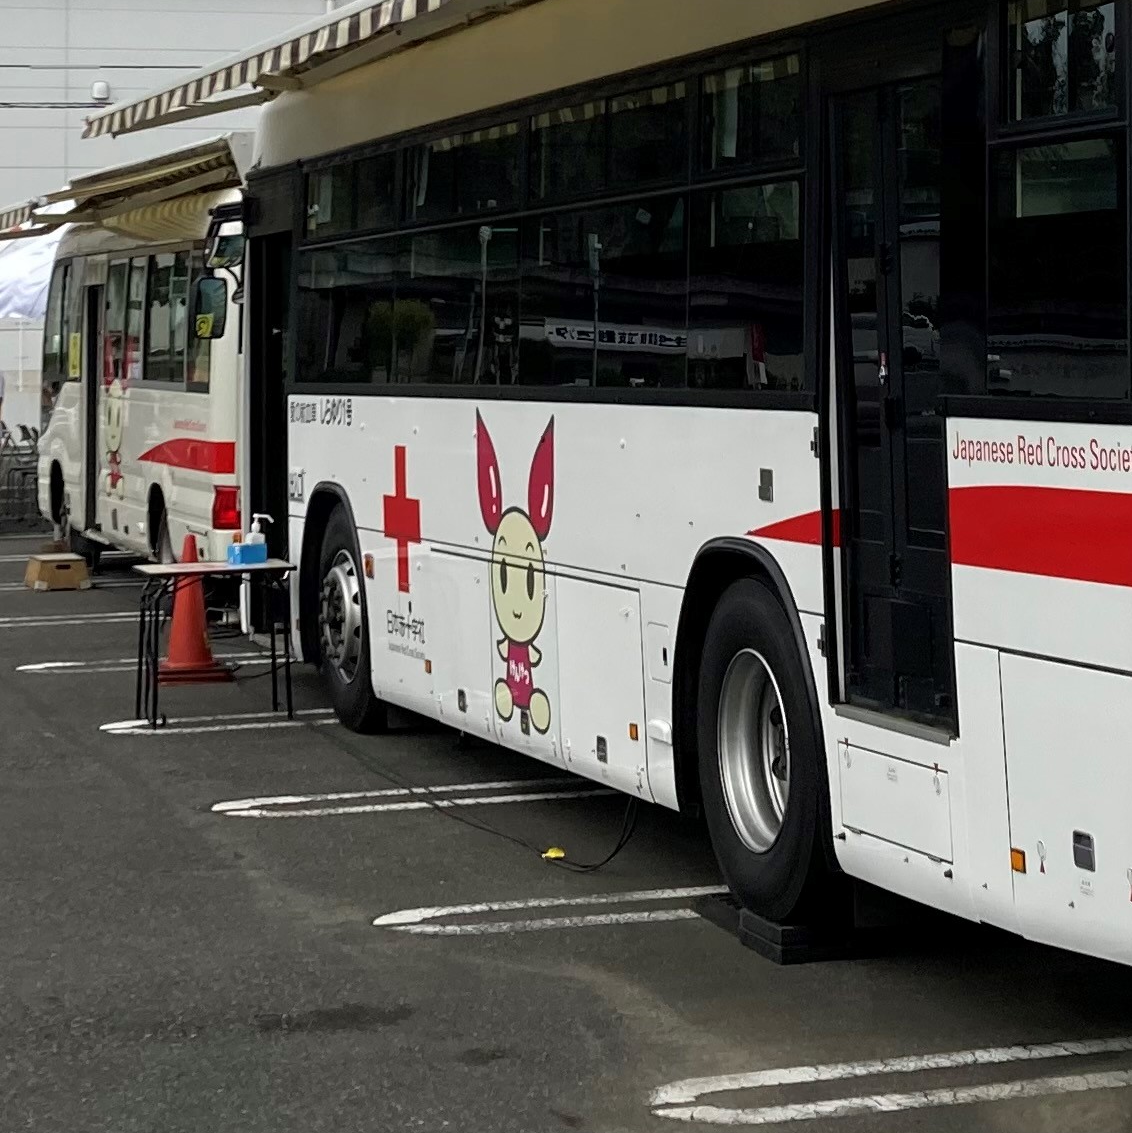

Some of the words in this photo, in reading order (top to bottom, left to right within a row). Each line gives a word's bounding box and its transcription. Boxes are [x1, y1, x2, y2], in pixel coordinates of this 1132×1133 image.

[952, 431, 1014, 468] Japanese
[1017, 435, 1043, 466] Red
[1046, 436, 1086, 469] Cross
